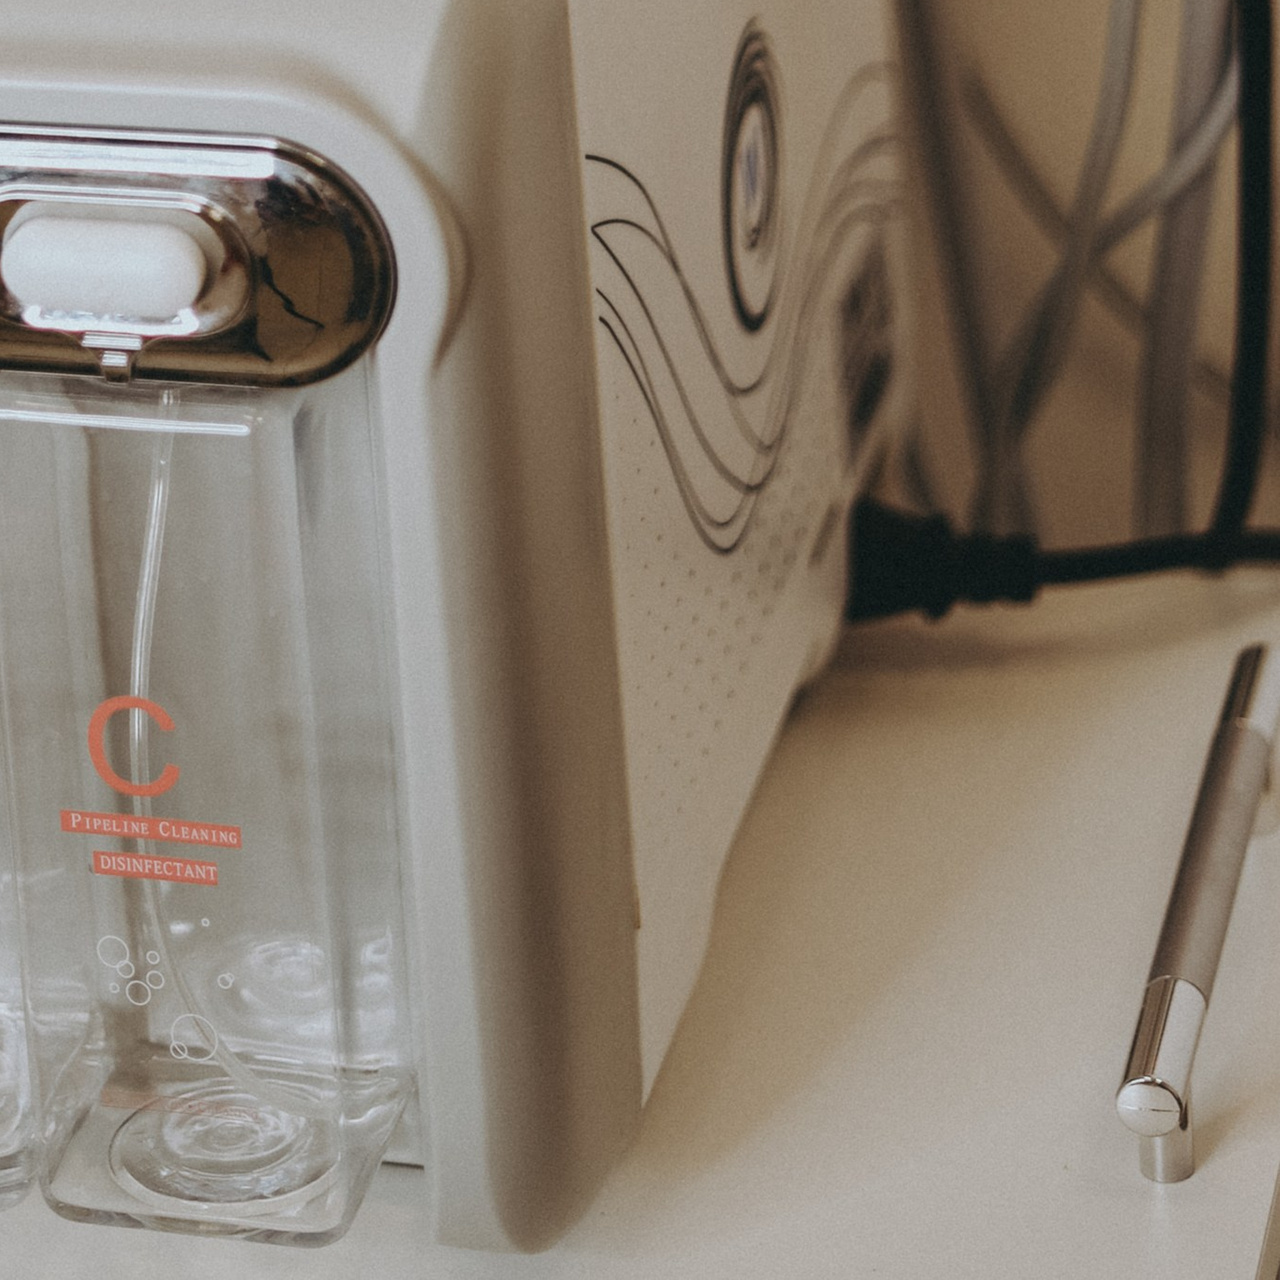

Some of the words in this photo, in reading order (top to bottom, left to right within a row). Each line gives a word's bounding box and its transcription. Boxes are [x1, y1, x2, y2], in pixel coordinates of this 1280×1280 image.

[87, 695, 180, 797] C
[70, 812, 149, 835] PIPELINE
[158, 821, 238, 845] CLEANING
[99, 854, 217, 881] DISINFECTANT
